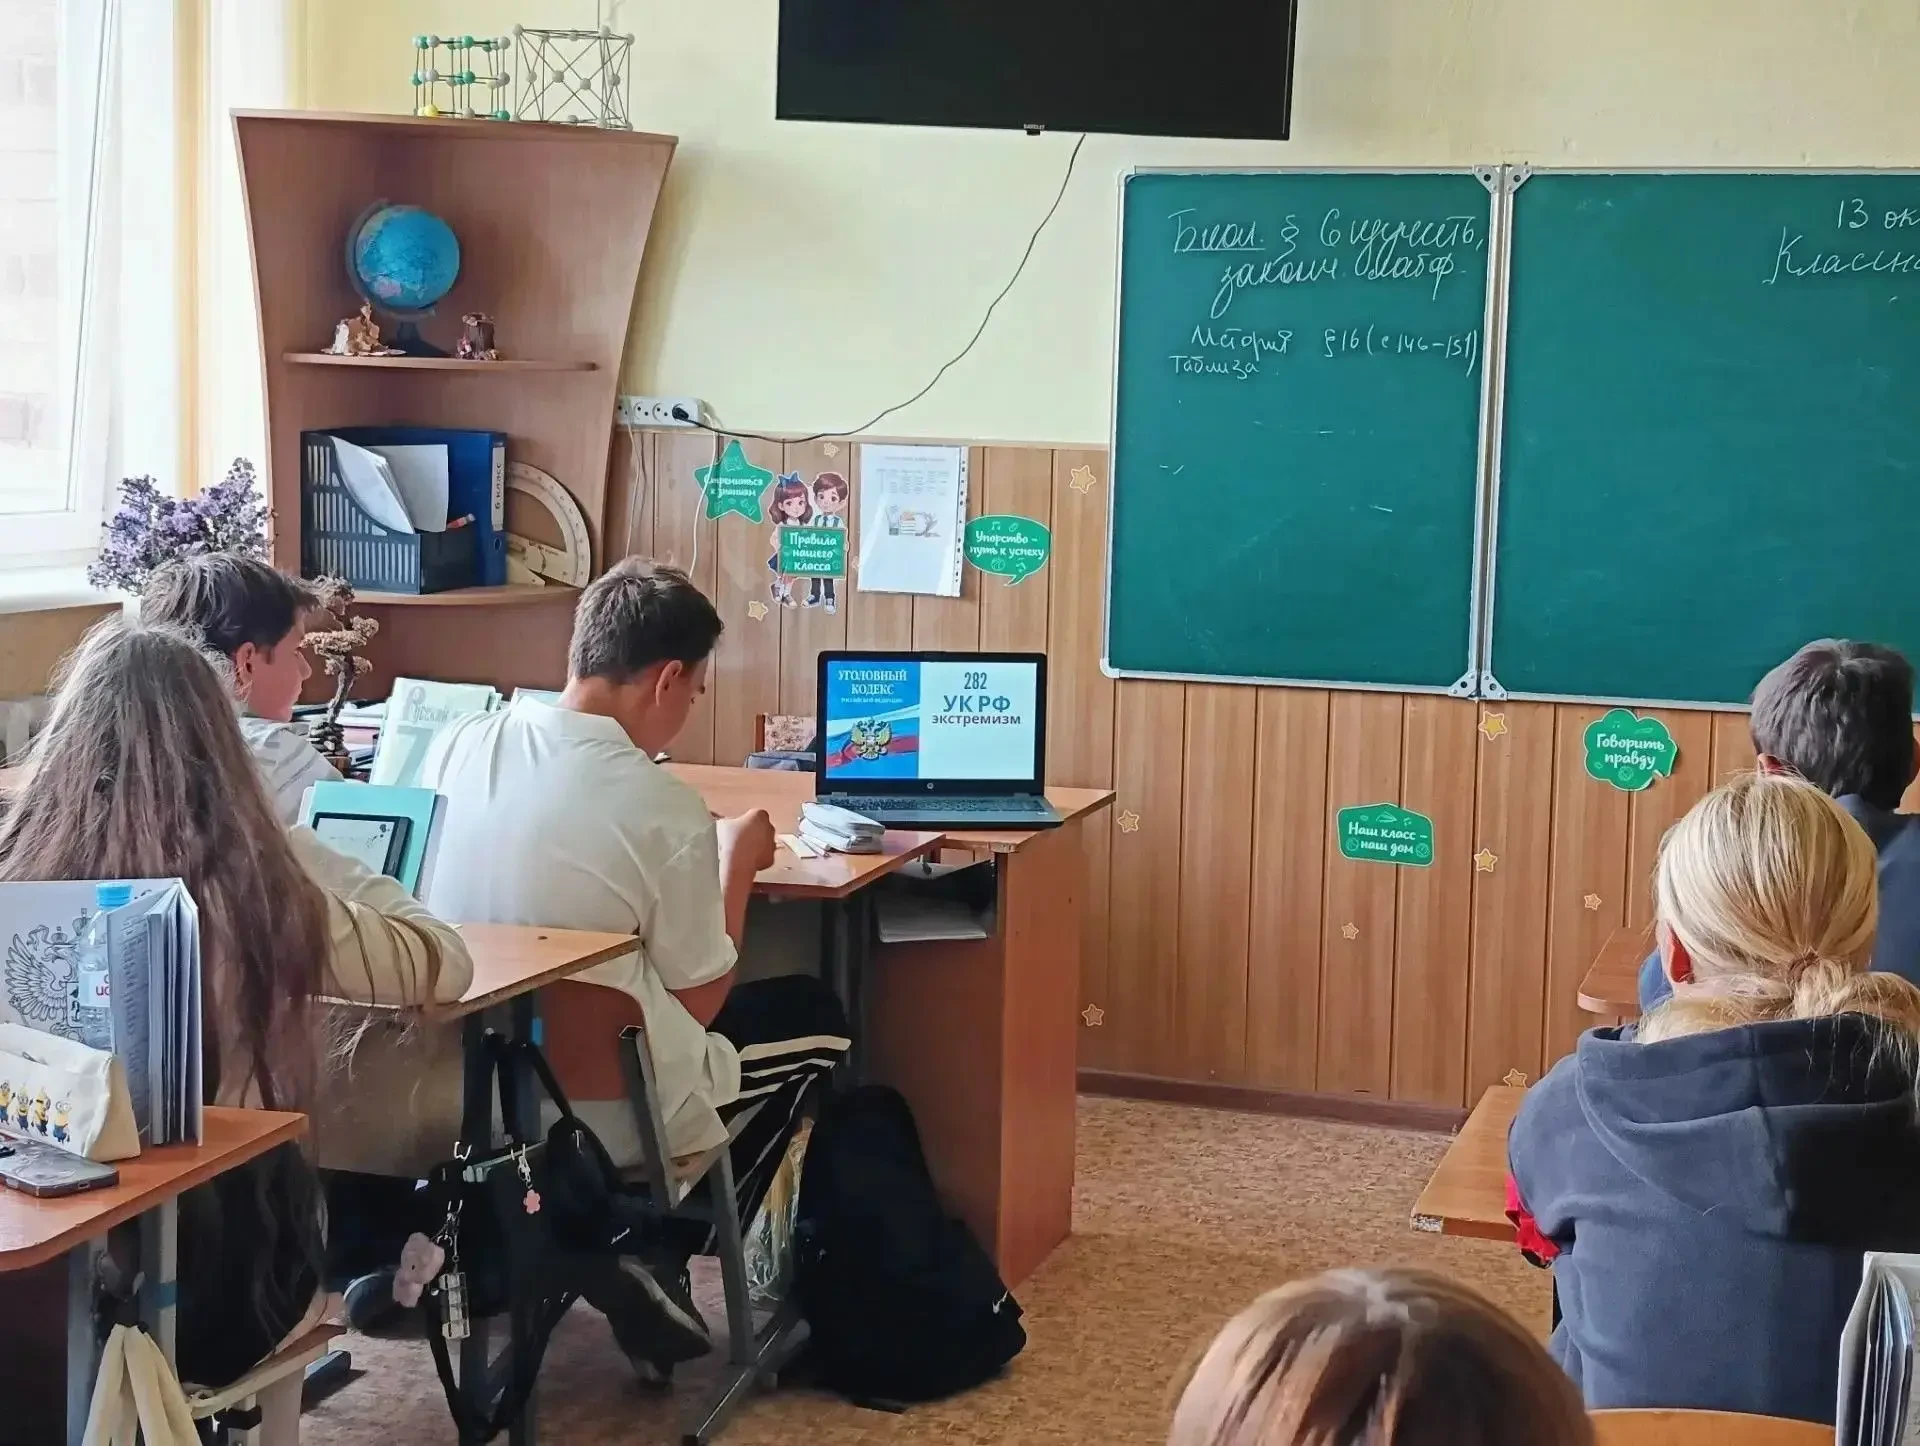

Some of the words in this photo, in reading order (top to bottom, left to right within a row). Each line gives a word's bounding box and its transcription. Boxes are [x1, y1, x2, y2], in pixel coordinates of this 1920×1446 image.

[1837, 198, 1869, 229] 13
[789, 531, 837, 549] Правила
[975, 530, 1029, 547] Упорство
[792, 549, 834, 559] нашего
[969, 546, 999, 558] путь
[1000, 547, 1007, 556] к
[1008, 547, 1045, 560] успеху
[793, 561, 832, 571] класса
[838, 669, 908, 681] УГОЛОВНЫЙ
[964, 671, 987, 690] 282
[851, 683, 895, 696] КОДЕКС
[943, 695, 973, 713] УК
[978, 695, 1011, 713] РФ
[931, 714, 1021, 728] экстремизм
[1596, 733, 1665, 753] Говорить
[1604, 750, 1657, 770] правду
[1348, 821, 1378, 837] Наш
[1380, 828, 1416, 840] класс
[1360, 841, 1388, 851] наш
[1389, 843, 1414, 857] дом
